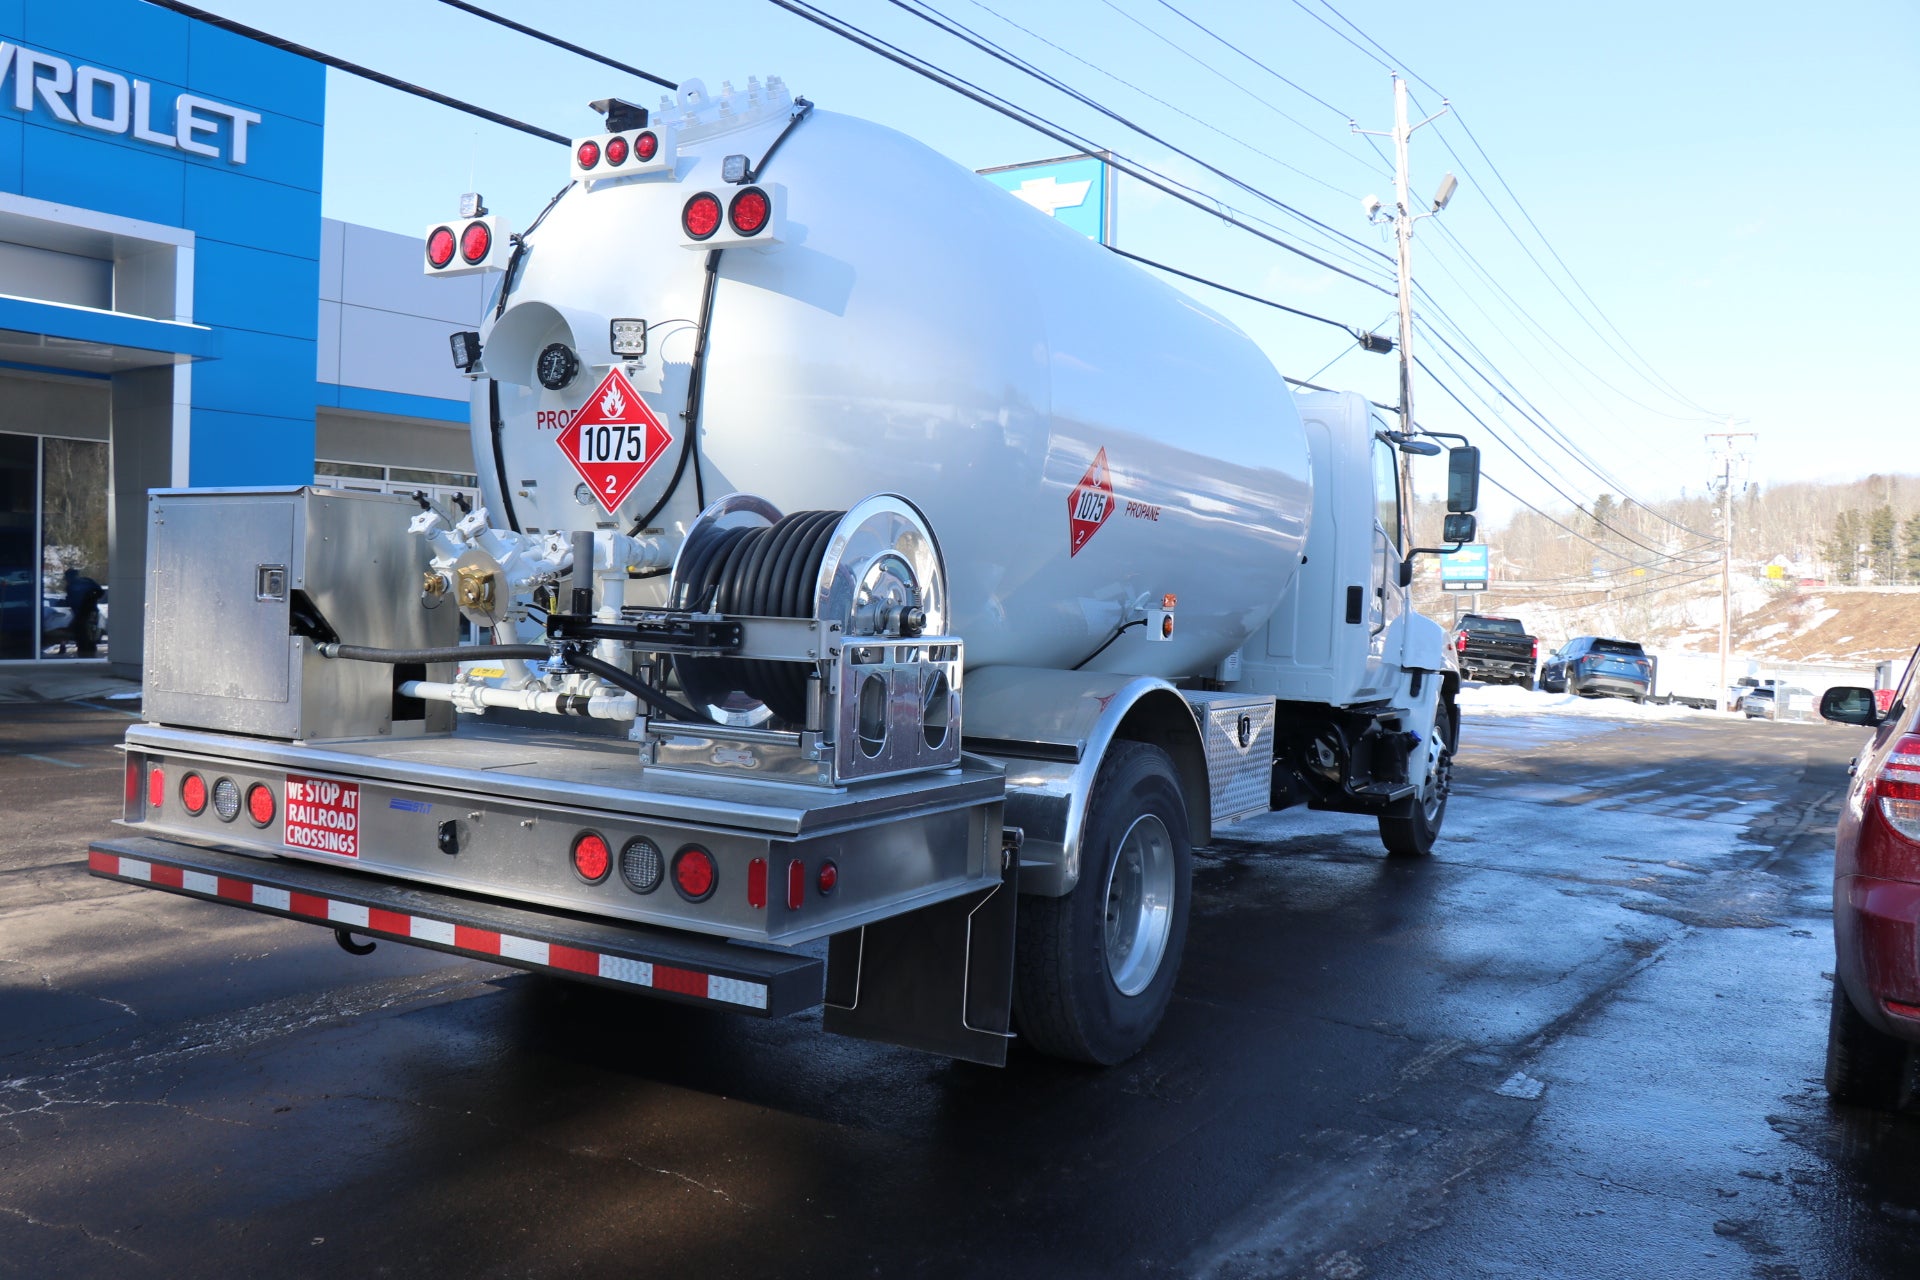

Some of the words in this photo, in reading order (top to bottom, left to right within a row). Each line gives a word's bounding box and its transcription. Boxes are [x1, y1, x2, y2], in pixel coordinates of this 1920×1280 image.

[584, 426, 641, 462] 1075
[605, 475, 617, 494] 2
[1077, 491, 1106, 521] 1075
[1124, 501, 1161, 522] PROPANE
[1075, 530, 1085, 544] 2
[288, 781, 303, 801] WE
[305, 779, 341, 806] STOP
[342, 790, 357, 809] AT
[288, 804, 356, 831] RAILROAD
[287, 826, 356, 854] CROSSINGS
